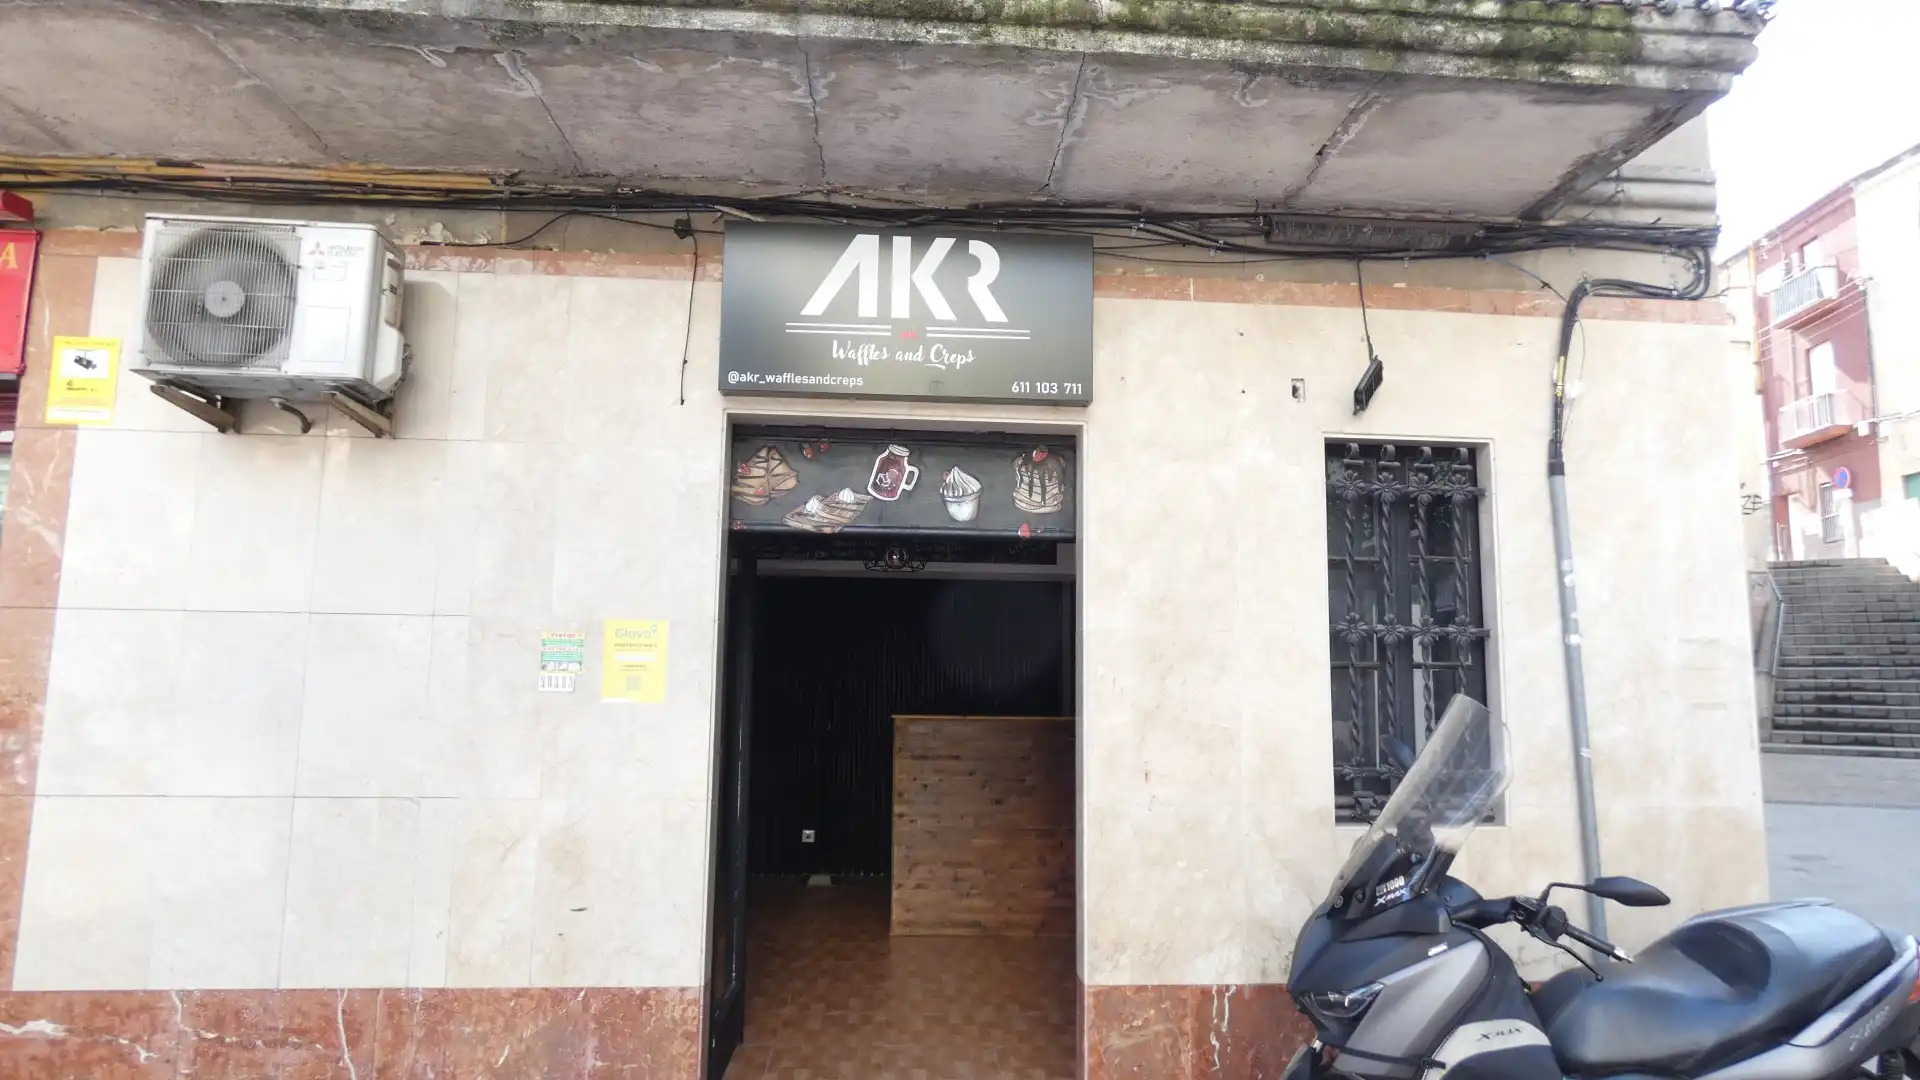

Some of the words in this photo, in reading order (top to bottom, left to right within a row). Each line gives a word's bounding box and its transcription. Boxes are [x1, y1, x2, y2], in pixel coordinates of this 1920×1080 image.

[799, 233, 1010, 323] AKR
[831, 339, 891, 366] Waffles
[895, 344, 924, 362] and
[923, 343, 977, 370] Creps
[727, 370, 864, 388] @akr_wafflesandcreps
[1011, 381, 1030, 394] 611
[1035, 382, 1058, 394] 103
[1063, 382, 1082, 395] 711
